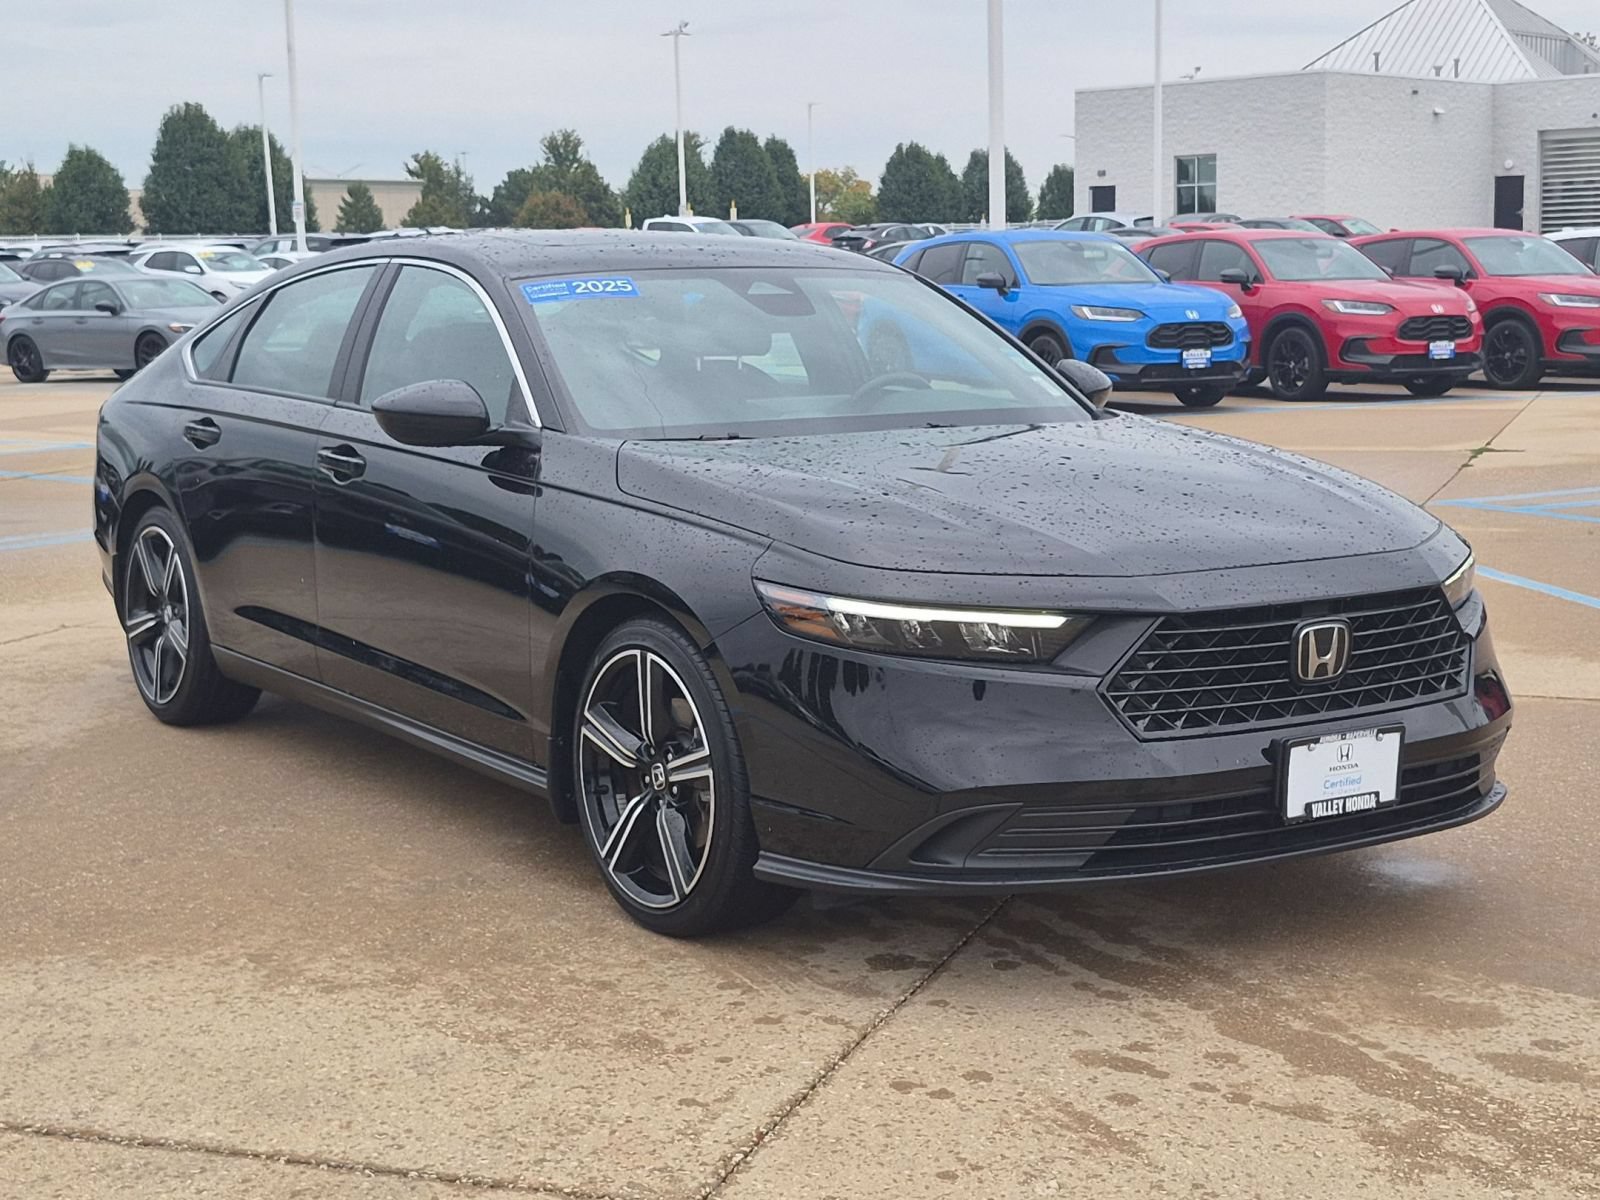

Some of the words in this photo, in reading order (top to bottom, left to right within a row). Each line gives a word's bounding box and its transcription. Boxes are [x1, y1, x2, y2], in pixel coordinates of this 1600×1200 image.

[572, 280, 632, 293] 2025
[1329, 763, 1359, 772] HONDA
[1323, 776, 1362, 790] Certified
[1312, 799, 1344, 818] VALLEY
[1345, 794, 1377, 813] HONDA
